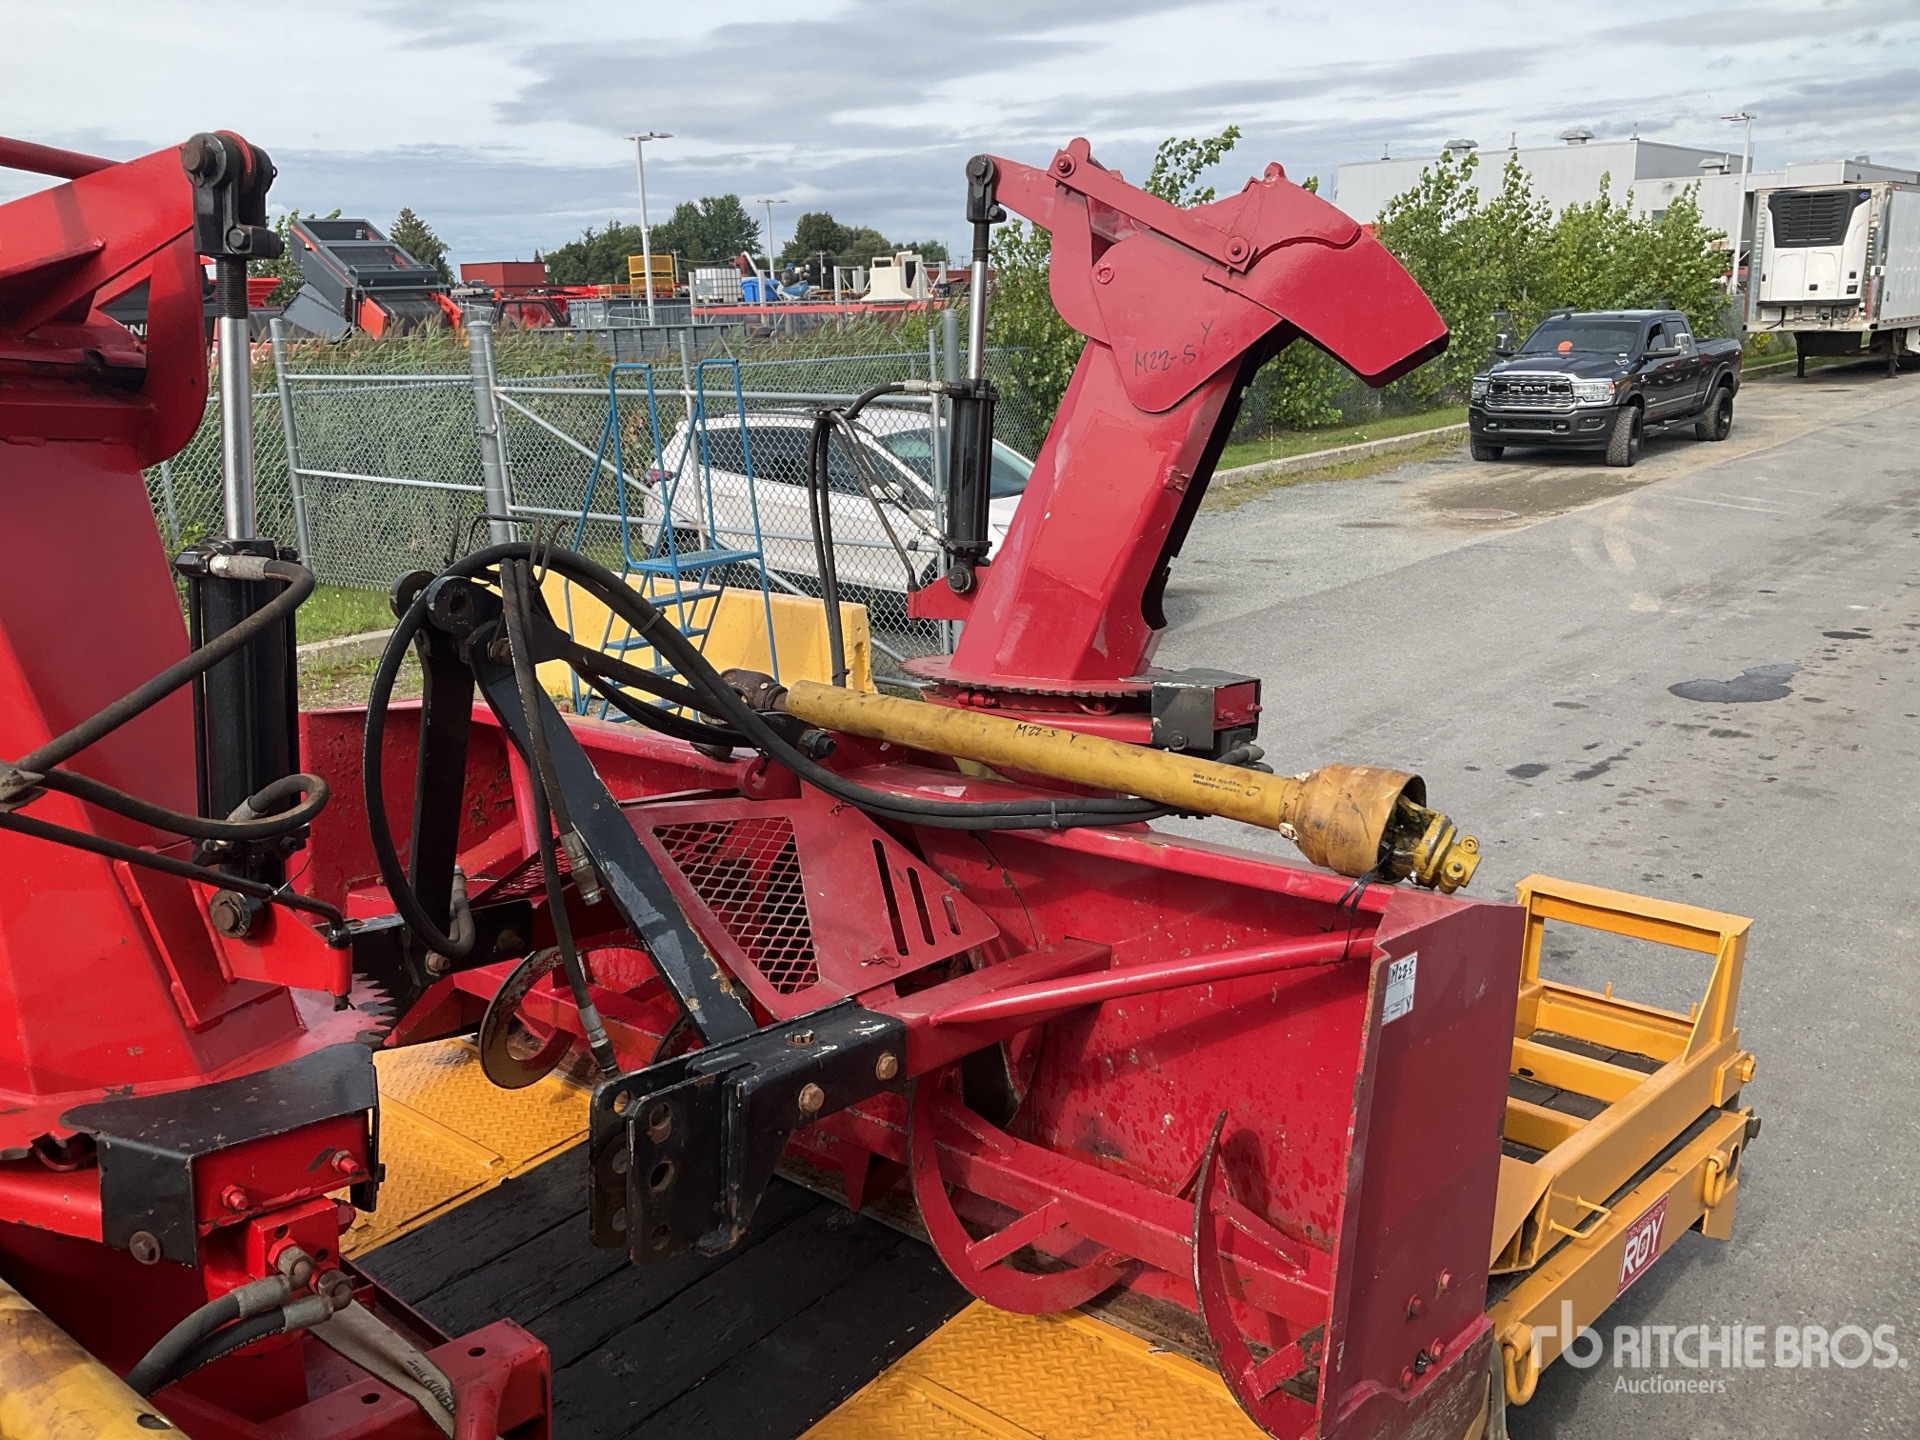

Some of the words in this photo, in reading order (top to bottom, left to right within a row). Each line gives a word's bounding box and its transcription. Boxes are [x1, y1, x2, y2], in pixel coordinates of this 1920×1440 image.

[1200, 319, 1214, 345] Y
[1070, 733, 1080, 744] Y
[1620, 1210, 1666, 1284] ROY
